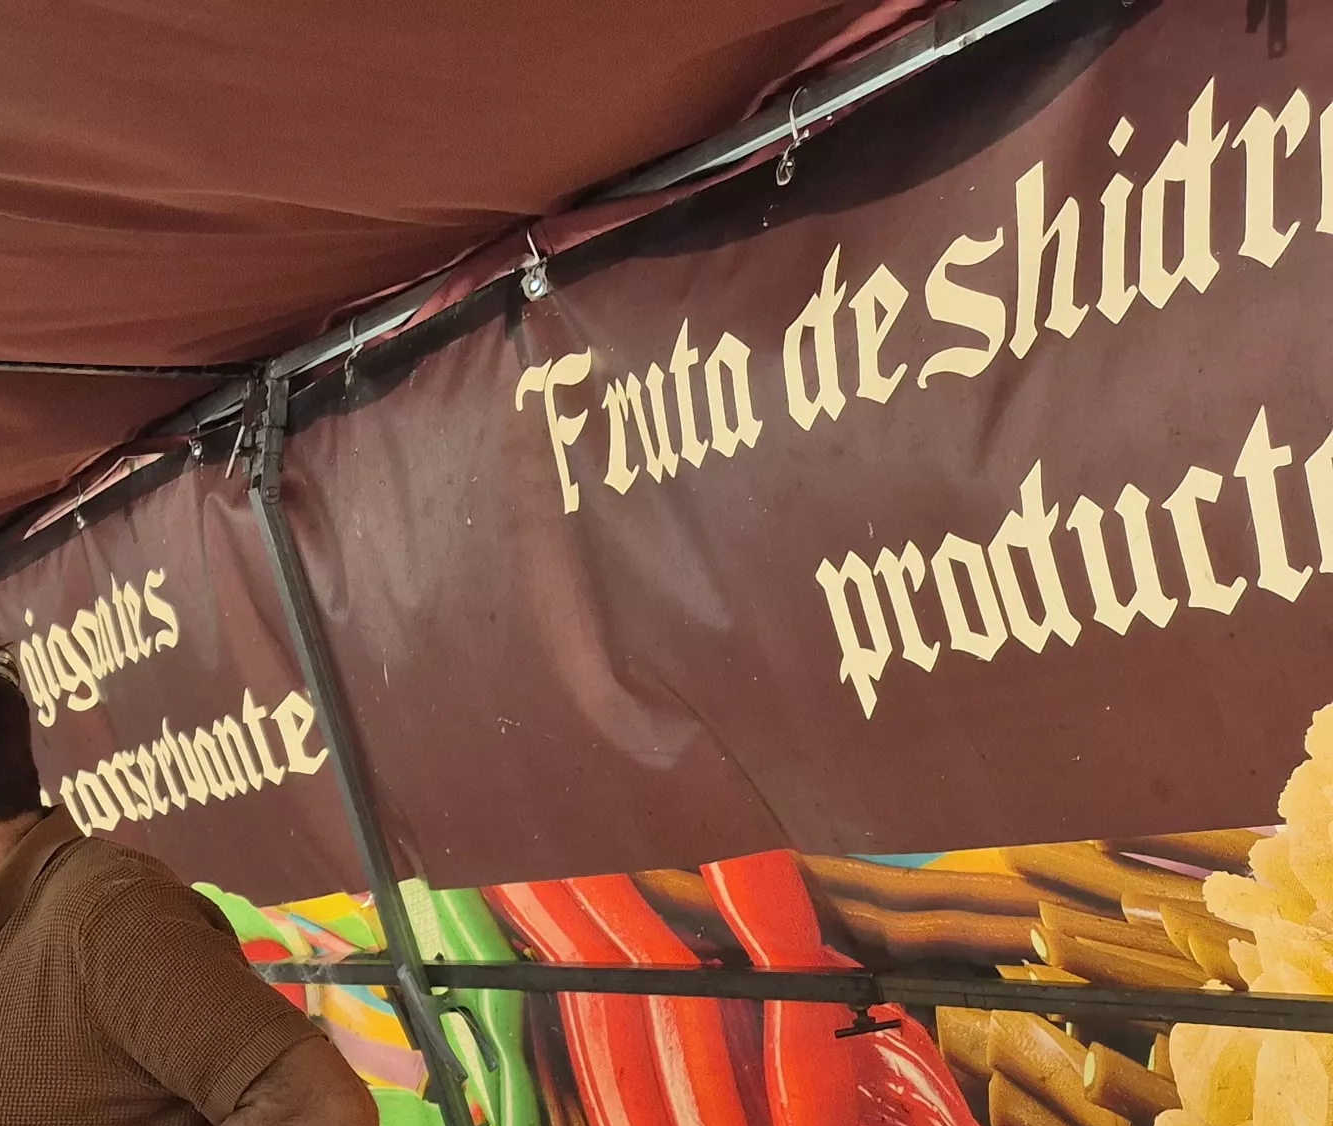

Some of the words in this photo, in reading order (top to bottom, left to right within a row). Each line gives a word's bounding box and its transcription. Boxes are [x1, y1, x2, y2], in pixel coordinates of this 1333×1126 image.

[515, 317, 764, 515] Fruta
[783, 75, 1333, 431] deshidr
[20, 566, 180, 728] gigantes
[59, 687, 330, 838] conservante
